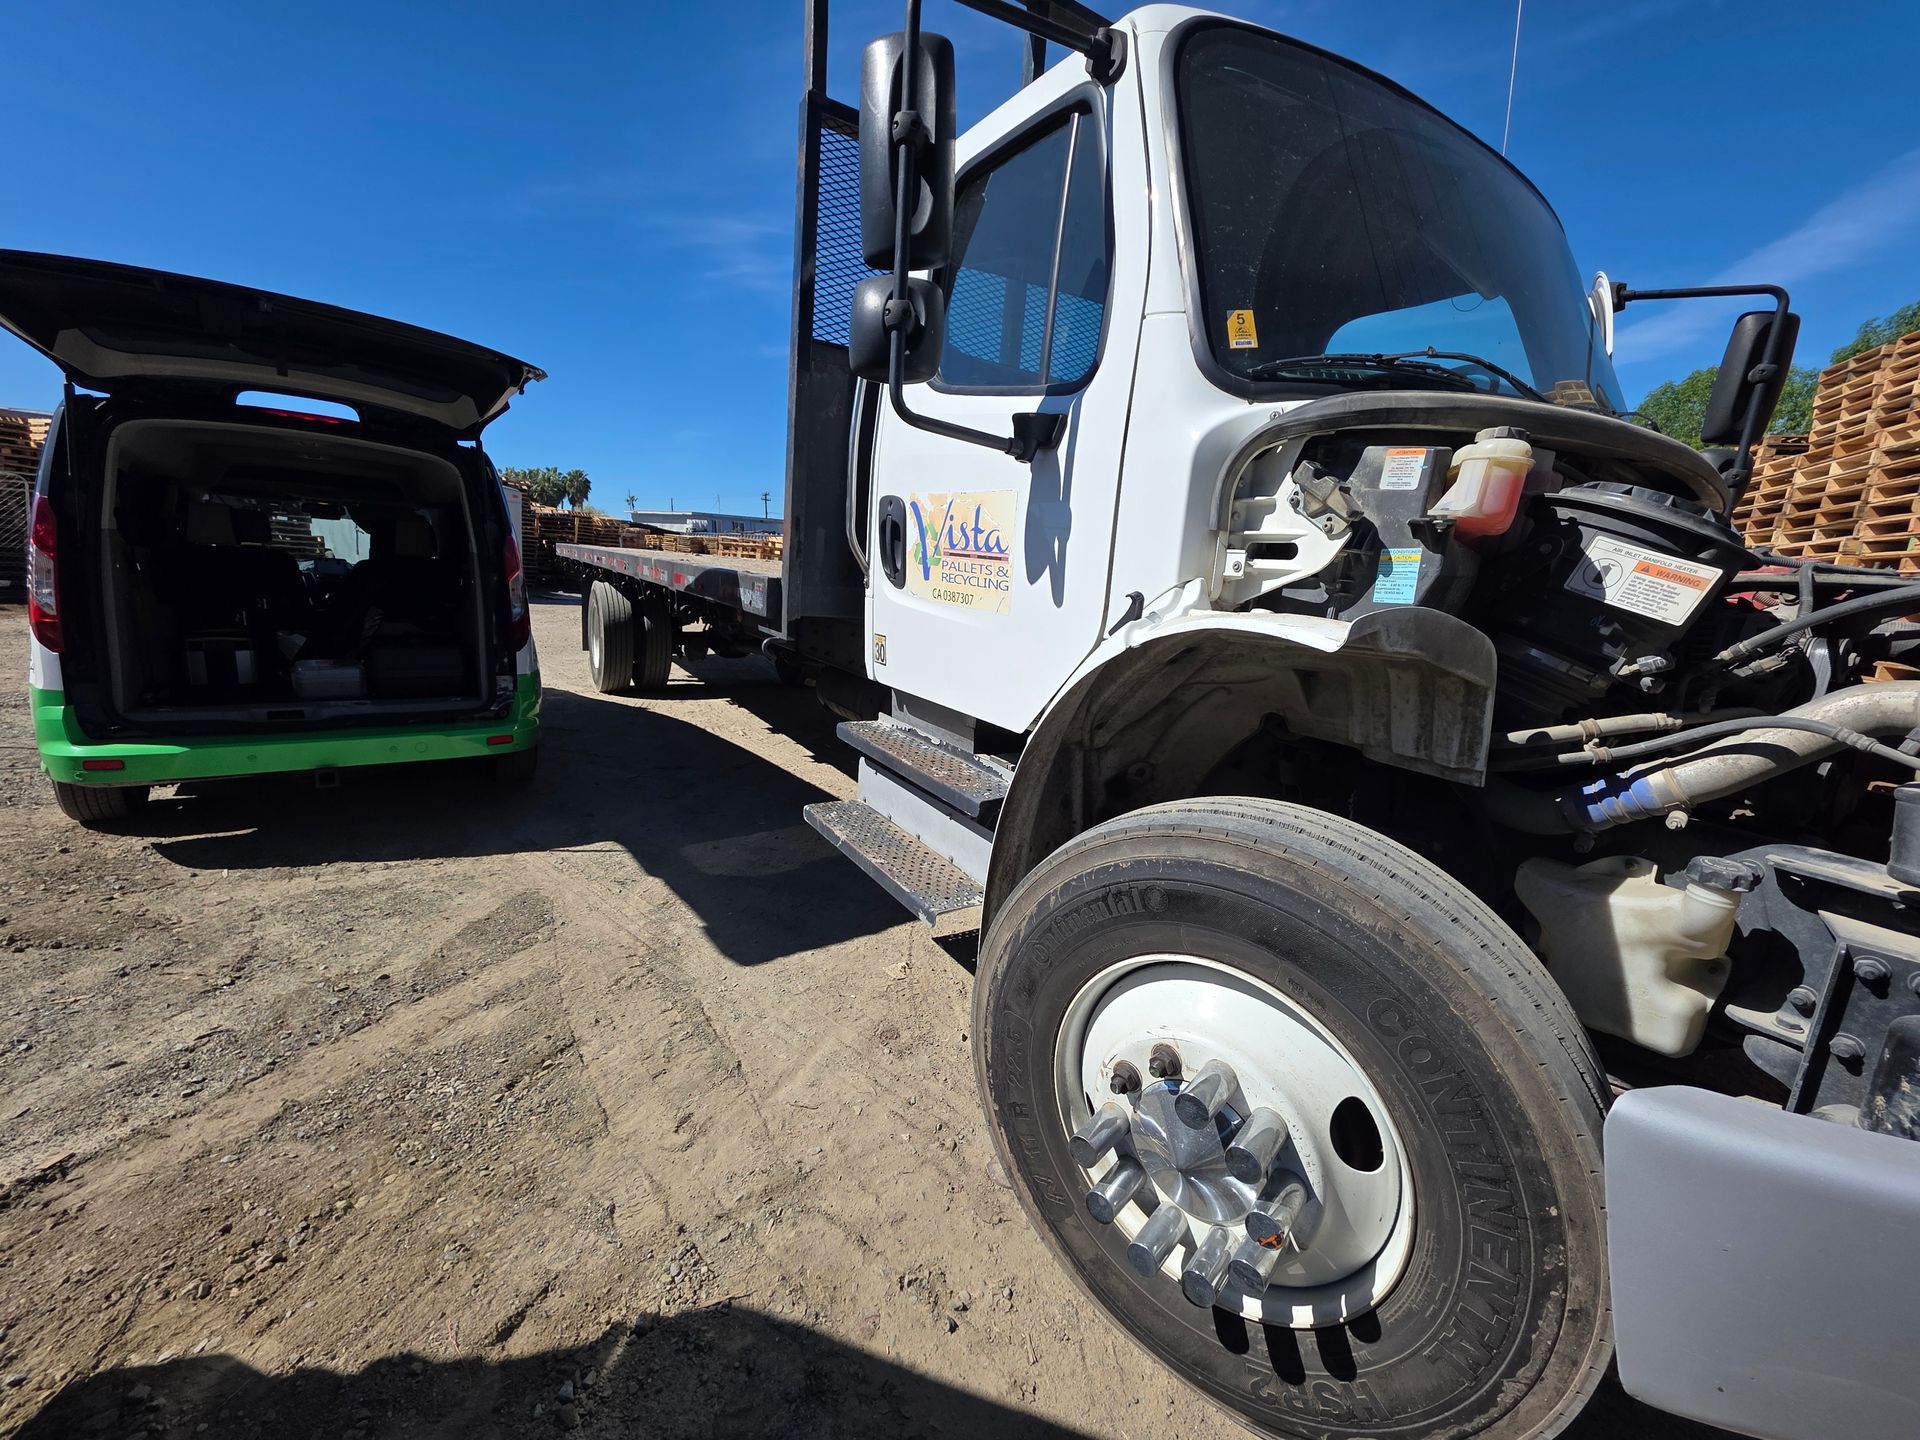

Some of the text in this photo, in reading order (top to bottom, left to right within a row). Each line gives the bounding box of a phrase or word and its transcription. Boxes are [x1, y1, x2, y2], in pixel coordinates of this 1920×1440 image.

[1236, 313, 1246, 325] 5
[910, 498, 1009, 581] Vista
[941, 559, 1009, 579] PALLETS &
[1625, 550, 1640, 558] INLET
[1643, 555, 1672, 567] MANIFOLD
[1674, 564, 1697, 574] HEATER
[941, 572, 1009, 592] RECYCLING
[1656, 569, 1700, 587] WARNING
[932, 588, 974, 606] CA 0387307
[875, 642, 885, 662] 30
[1031, 884, 1146, 965] Continental
[1004, 1026, 1024, 1090] 22.5
[1013, 1102, 1031, 1121] R
[1367, 998, 1522, 1388] CONTINENTAL
